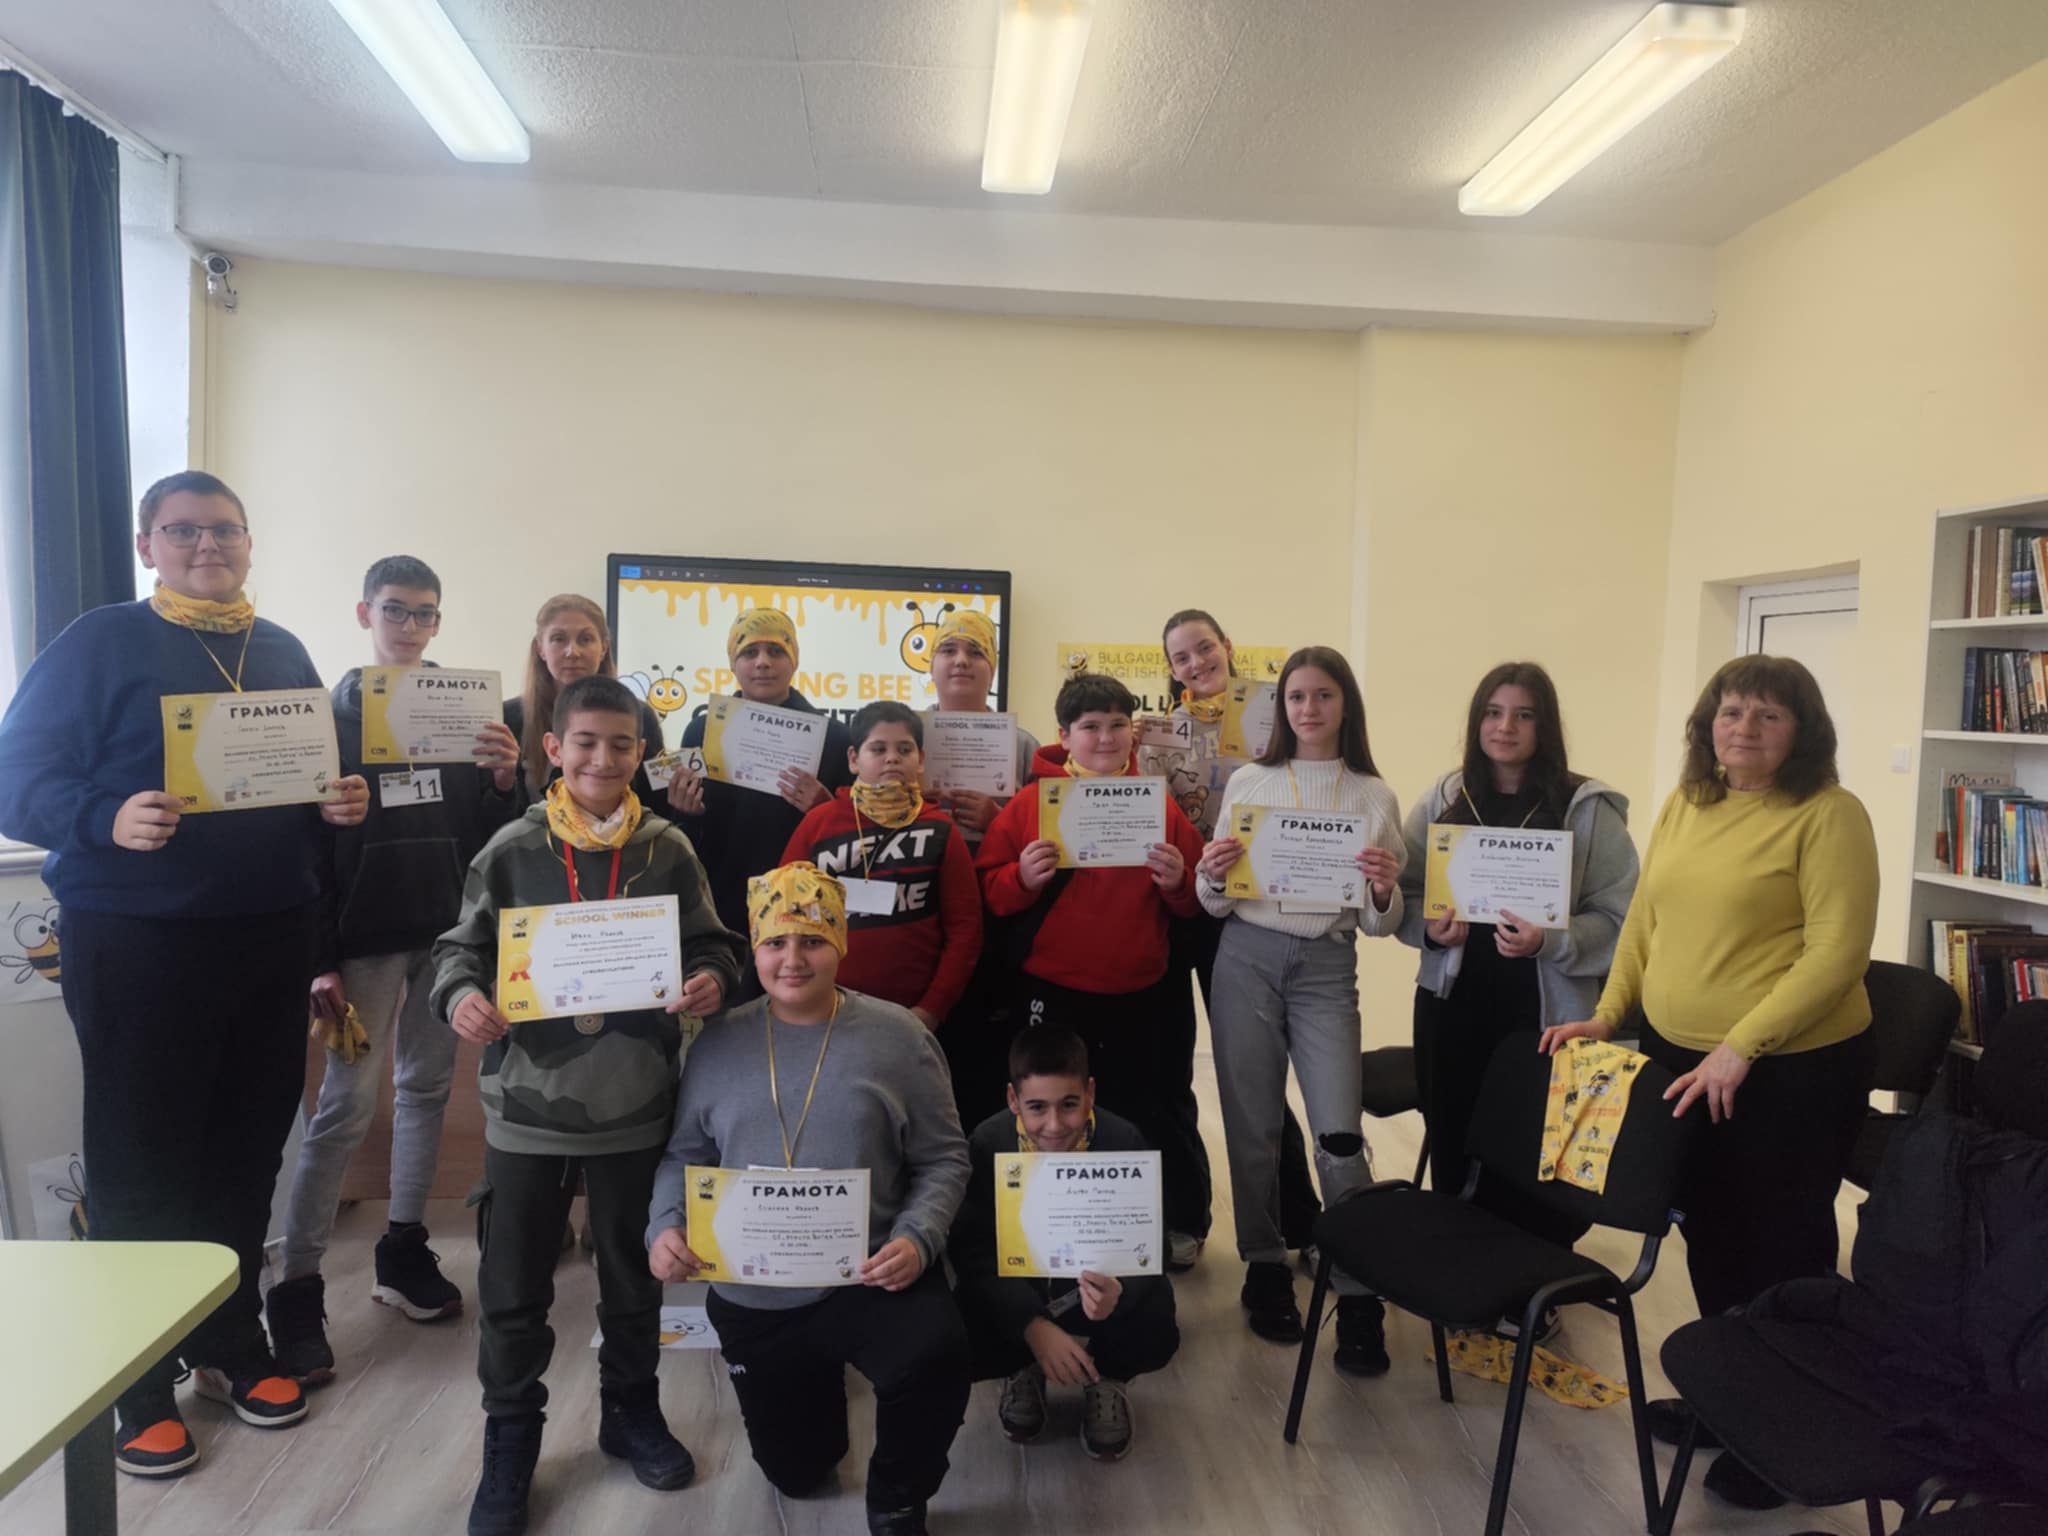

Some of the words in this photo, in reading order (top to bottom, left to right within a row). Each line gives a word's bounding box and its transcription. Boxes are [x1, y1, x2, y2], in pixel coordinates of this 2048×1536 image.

[1098, 652, 1168, 665] BULGARI
[417, 679, 487, 690] ГРАМОТА
[858, 672, 912, 700] BEE
[230, 703, 314, 719] ГРАМОТА
[750, 712, 811, 733] ГРАМОТА
[1175, 721, 1188, 741] 4
[688, 751, 703, 772] 6
[413, 778, 441, 800] 11
[1085, 787, 1151, 797] ГРАМОТА
[1281, 819, 1354, 833] ГРАМОТА
[1479, 838, 1555, 851] ГРАМОТА
[553, 911, 608, 926] SCHOOL
[611, 905, 666, 920] WINNER
[1056, 1167, 1142, 1180] ГРАМОТА
[752, 1184, 848, 1198] ГРАМОТА
